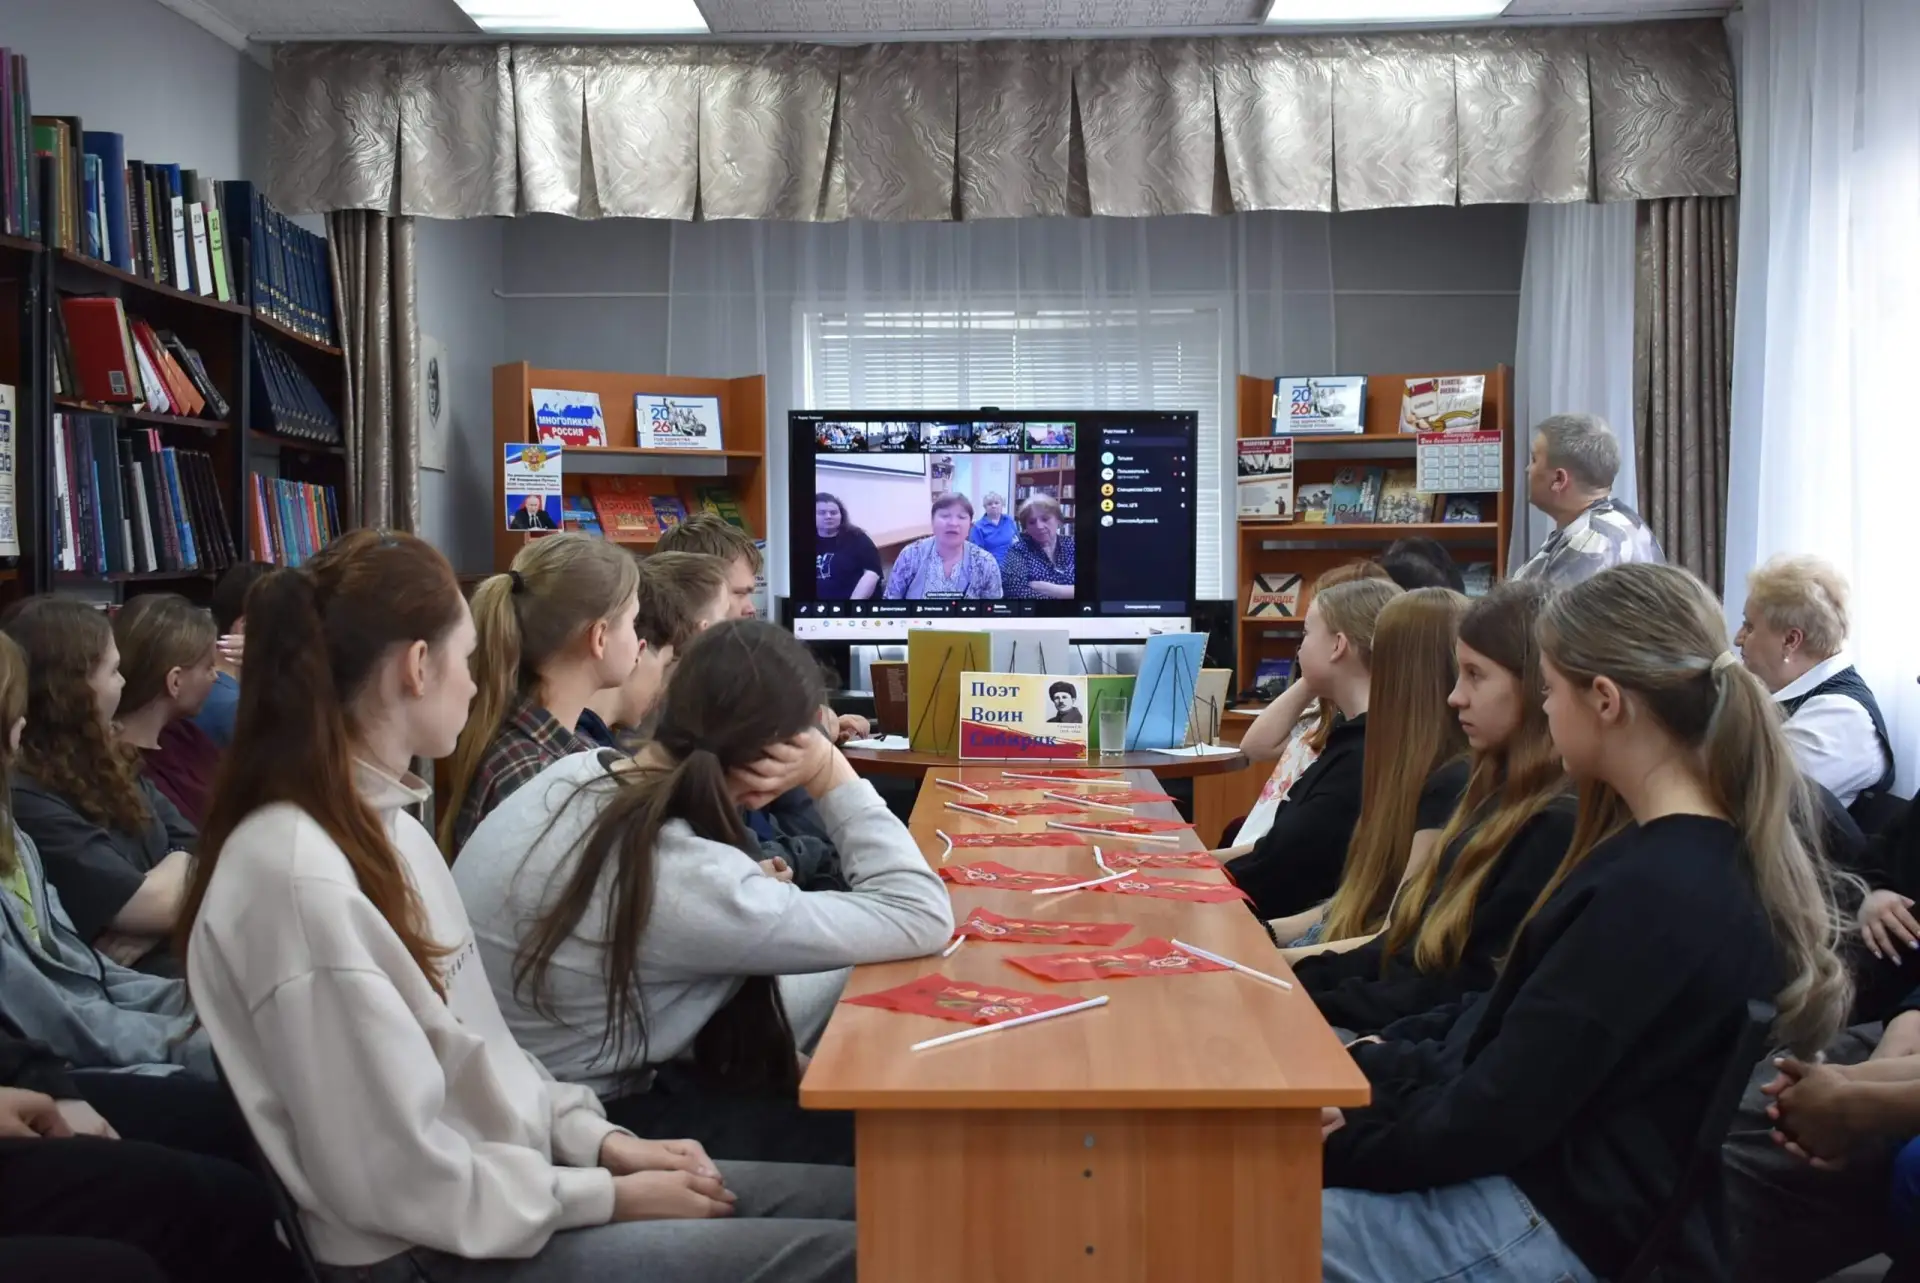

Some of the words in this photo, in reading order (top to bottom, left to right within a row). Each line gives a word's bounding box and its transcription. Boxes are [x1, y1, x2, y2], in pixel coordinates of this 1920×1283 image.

[1292, 389, 1311, 402] 20
[650, 407, 669, 420] 20
[1291, 402, 1309, 415] 26
[539, 415, 593, 427] МНОГОЛИКАЯ
[652, 420, 671, 433] 26
[552, 427, 584, 437] РОССИЯ
[1332, 503, 1364, 517] 1941
[1253, 594, 1295, 605] БЛОКАДЕ
[971, 681, 1020, 697] Поэт
[971, 706, 1023, 722] Воин
[970, 730, 1057, 749] Сибиряк
